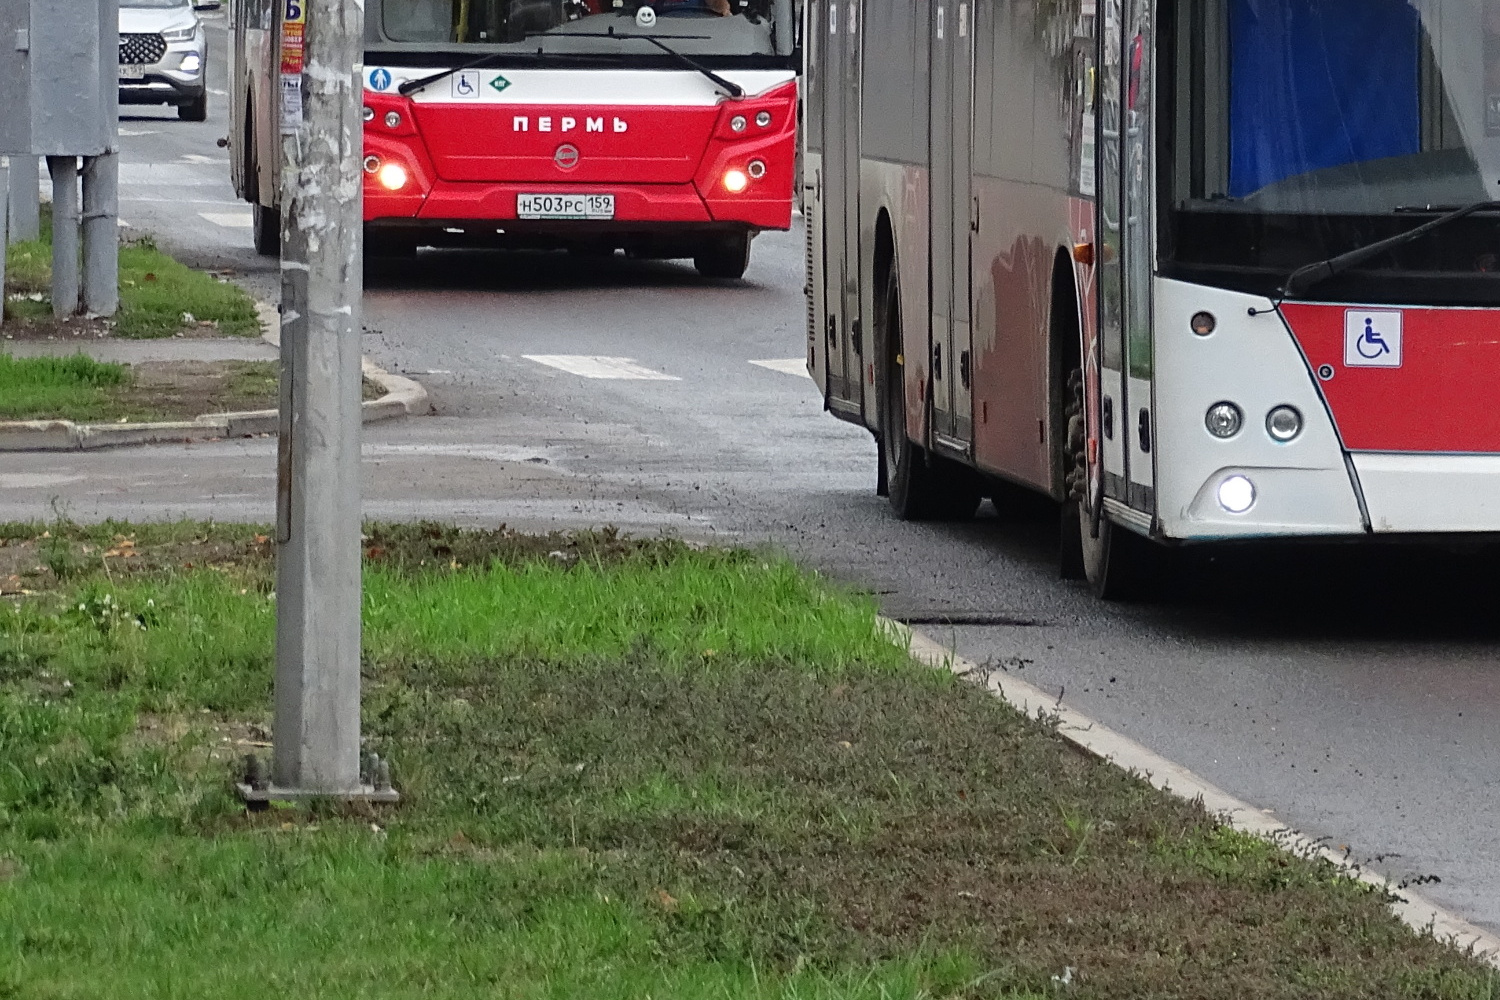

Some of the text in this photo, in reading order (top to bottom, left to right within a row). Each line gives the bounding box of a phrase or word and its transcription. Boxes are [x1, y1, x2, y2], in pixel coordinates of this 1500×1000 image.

[513, 116, 628, 132] ПЕРМЬ
[522, 197, 611, 213] Н503РС 159
